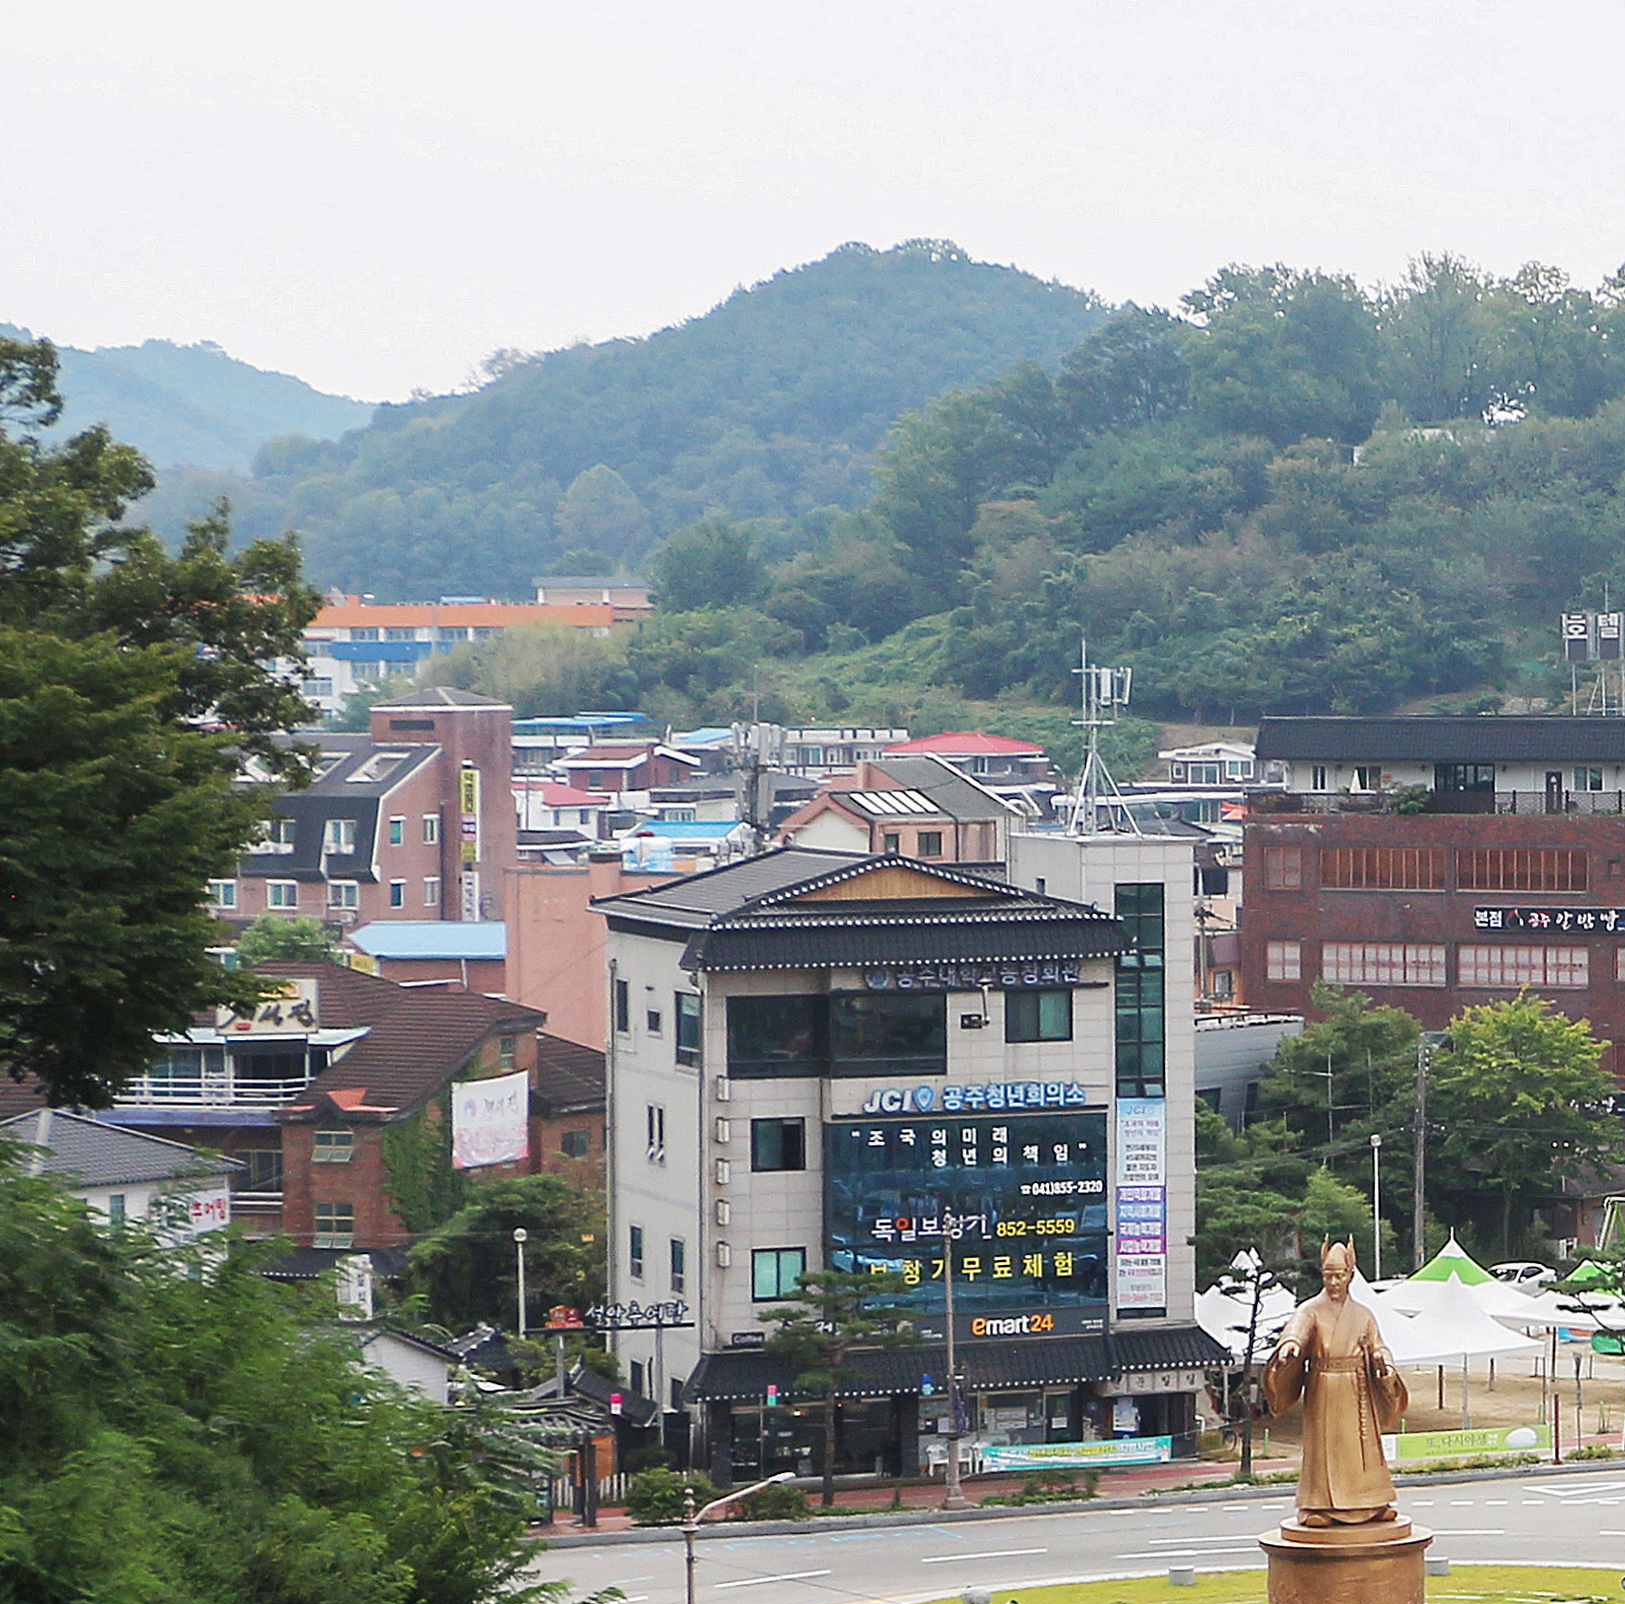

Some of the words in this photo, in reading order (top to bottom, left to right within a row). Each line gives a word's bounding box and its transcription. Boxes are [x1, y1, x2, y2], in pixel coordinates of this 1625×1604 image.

[1475, 910, 1503, 928] 본점
[864, 1091, 912, 1113] JCI
[943, 1084, 1085, 1109] 공주청년회의소
[997, 1218, 1075, 1237] 852-5559
[971, 1314, 1054, 1336] emart24
